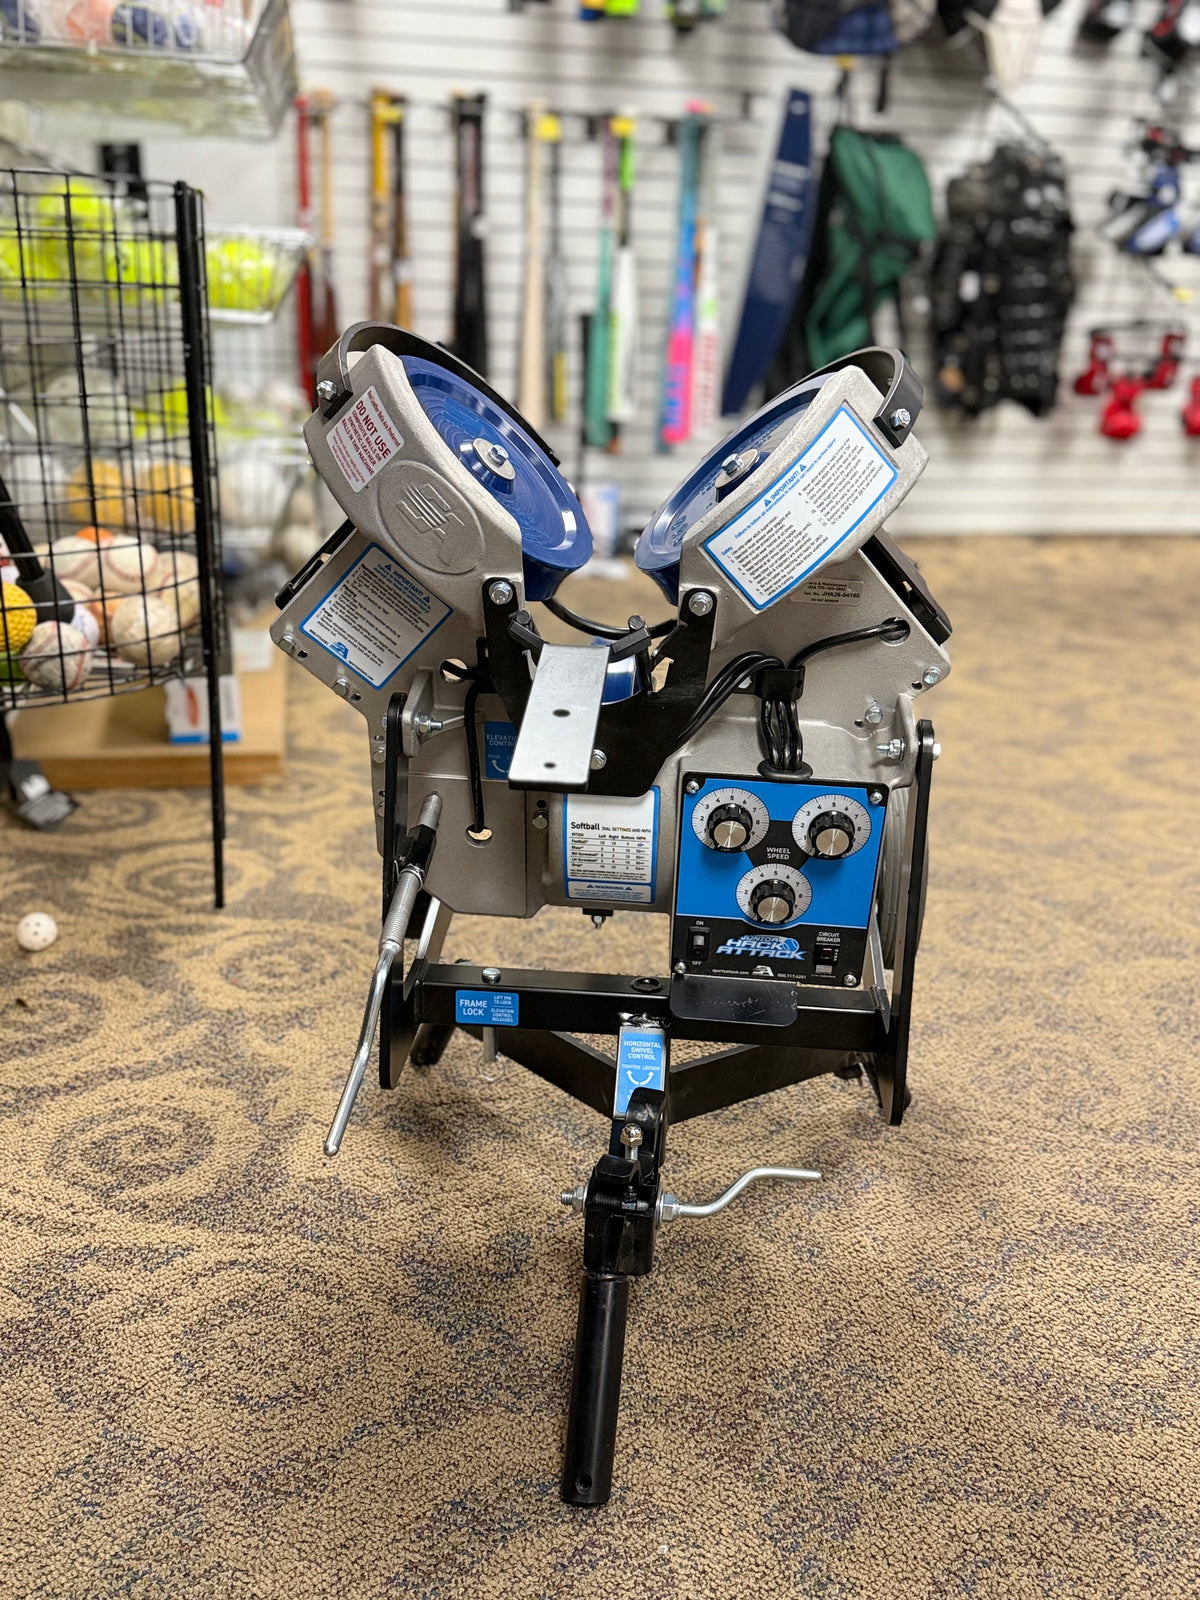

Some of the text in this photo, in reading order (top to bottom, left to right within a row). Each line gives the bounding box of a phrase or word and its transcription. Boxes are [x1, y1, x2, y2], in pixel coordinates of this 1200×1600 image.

[356, 400, 391, 458] DO NOT USE
[371, 398, 379, 412] Leather
[387, 427, 400, 447] Preferred
[348, 416, 376, 465] SYNTHETIC LEATHER
[352, 410, 382, 461] COMPOSITE BALLS OR
[342, 418, 350, 434] BALLS
[352, 440, 360, 452] THIS
[358, 452, 374, 475] MACHINE
[734, 528, 747, 538] Failure
[750, 516, 761, 525] follow
[765, 494, 785, 512] instructions
[788, 477, 800, 491] manual
[805, 463, 814, 473] result
[817, 448, 828, 460] serious
[827, 438, 836, 449] injury!
[771, 471, 799, 499] IMPORTANT!
[721, 546, 732, 555] Safety
[393, 570, 423, 596] IMPORTANT!
[571, 821, 600, 831] Softball
[715, 945, 808, 961] ATTACK
[725, 938, 784, 950] HACK
[459, 999, 488, 1008] FRAME
[463, 1008, 484, 1016] LOCK
[624, 1040, 662, 1048] HORIZONTAL
[631, 1046, 654, 1054] SWIVEL
